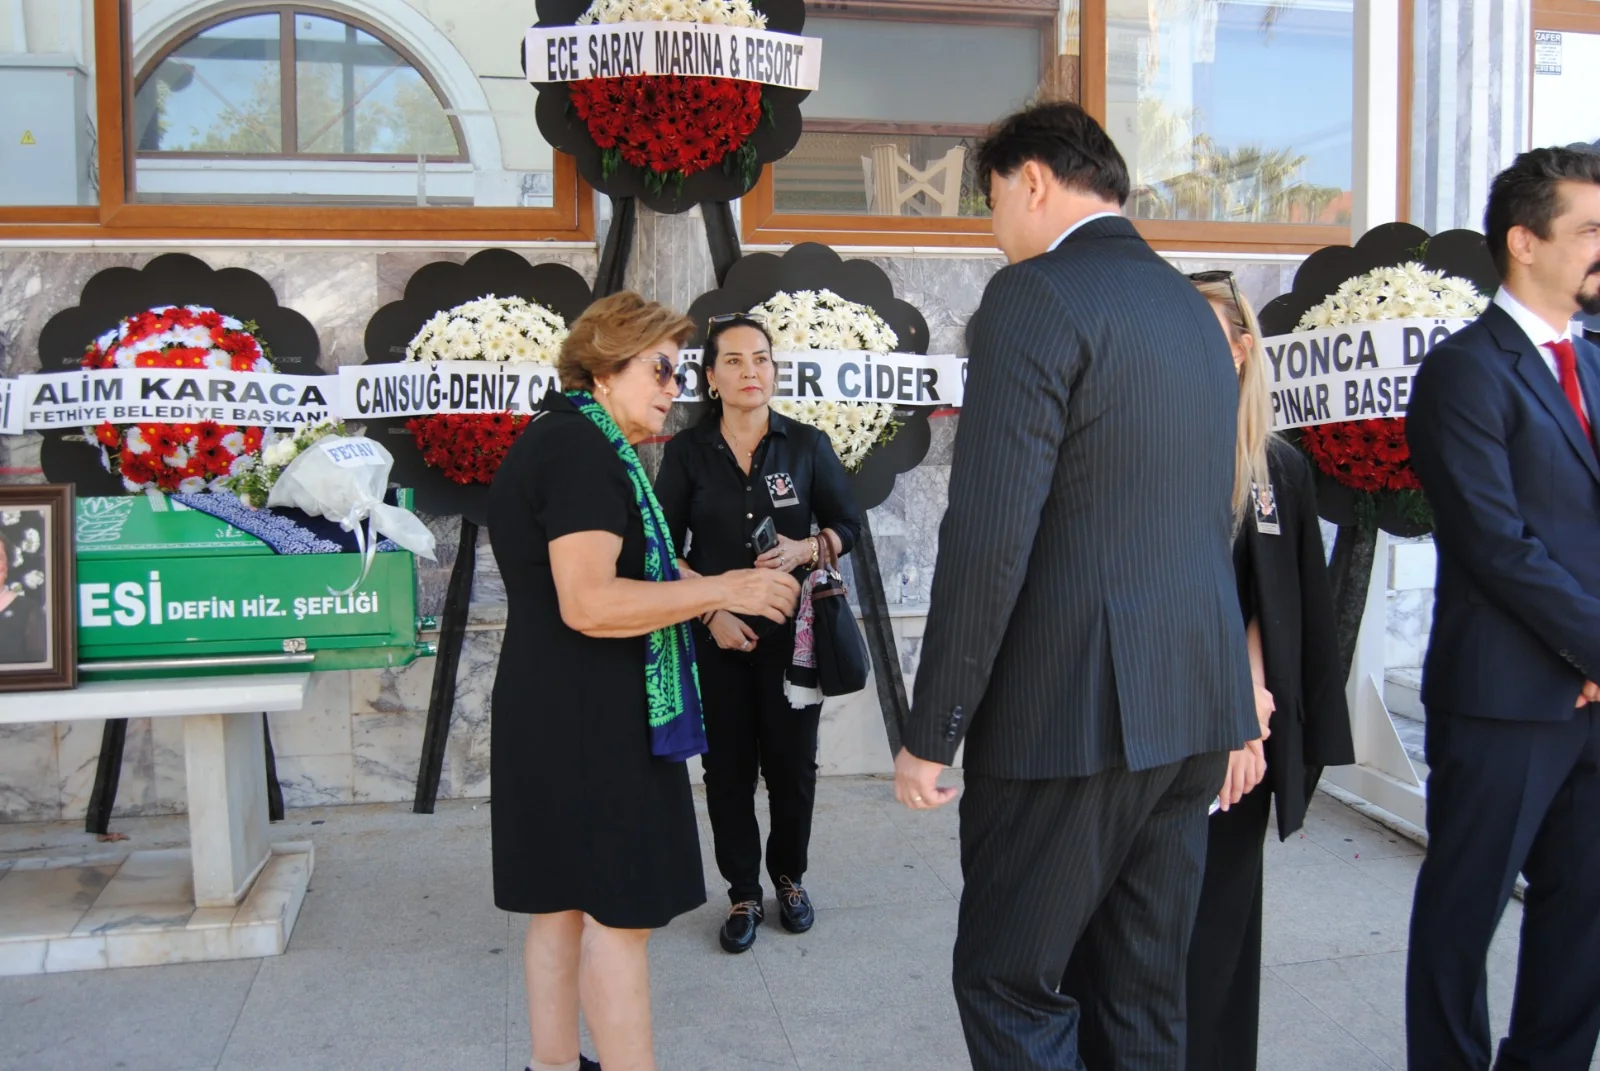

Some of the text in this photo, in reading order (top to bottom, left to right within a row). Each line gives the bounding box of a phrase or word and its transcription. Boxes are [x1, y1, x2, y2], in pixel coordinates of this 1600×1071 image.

[547, 25, 803, 86] ECE SARAY MARİNA & RESORT
[1536, 32, 1561, 42] ZAFER
[1265, 319, 1472, 382] YONCA DÖ
[33, 375, 327, 406] ALİM KARACA
[356, 365, 520, 414] CANSUĞ-DENİZ
[837, 355, 940, 401] CİDER
[1270, 376, 1416, 426] PINAR BAŞE
[30, 405, 107, 423] FETHİYE
[113, 403, 224, 419] BELEDİYE
[327, 443, 375, 461] FETAV
[79, 571, 378, 627] ESİ DEFİN HİZ. ŞEFLİĞİ
